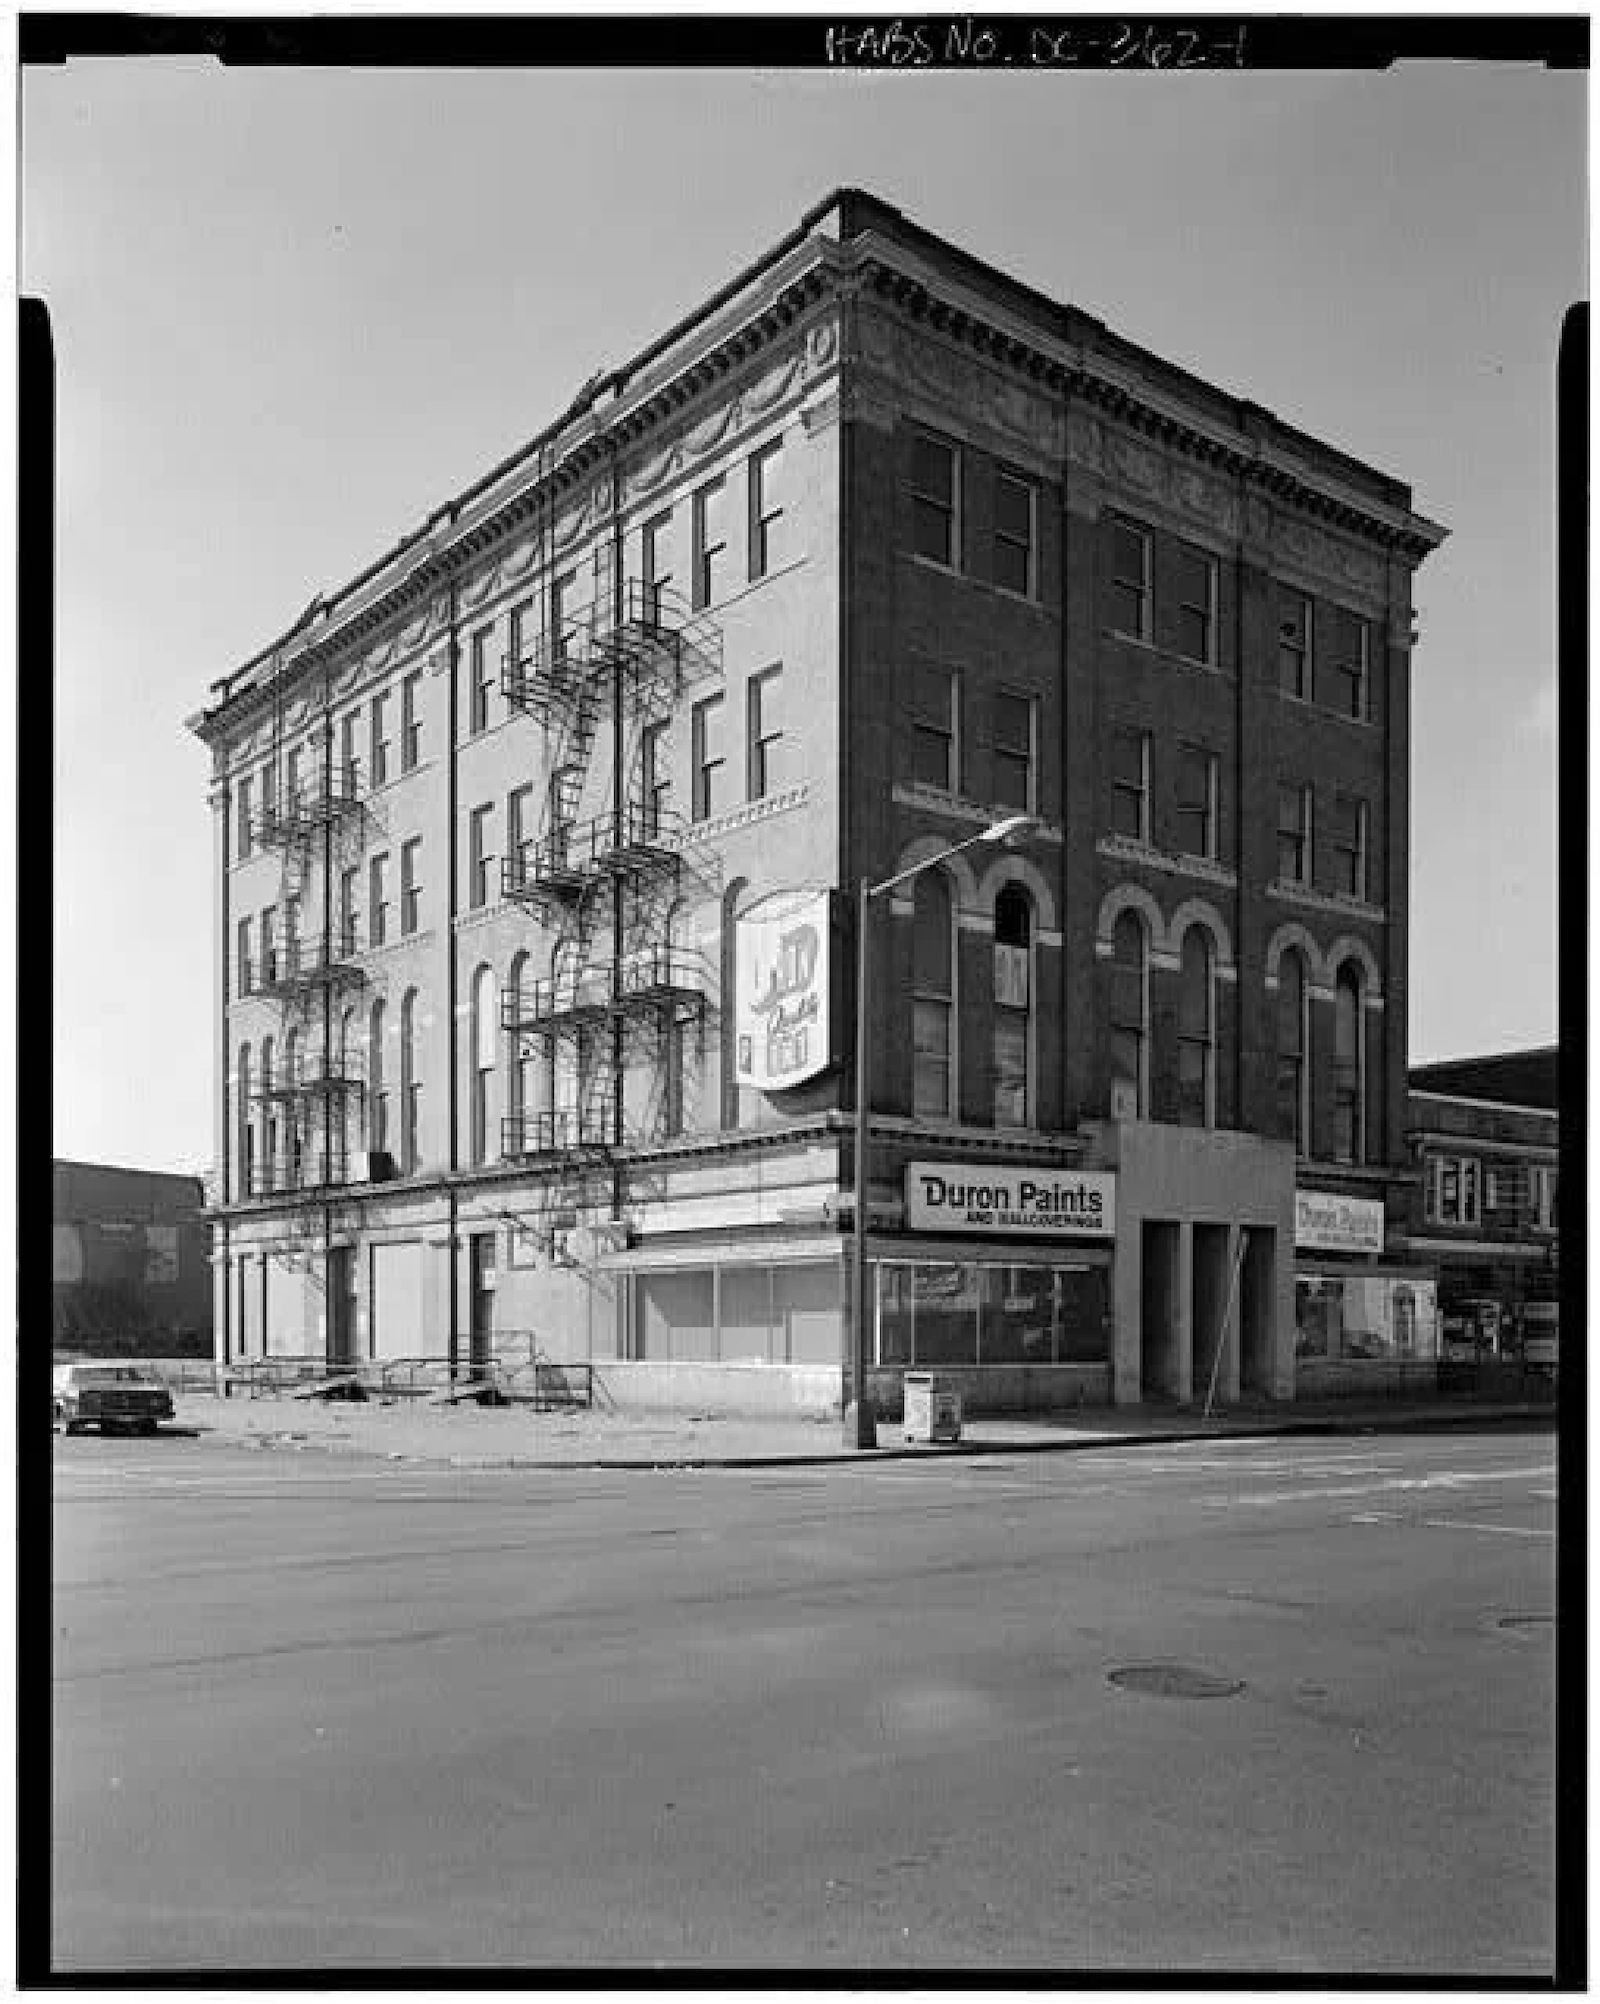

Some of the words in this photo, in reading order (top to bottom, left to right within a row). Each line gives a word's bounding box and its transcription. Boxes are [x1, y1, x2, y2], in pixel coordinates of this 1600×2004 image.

[920, 1177, 1009, 1209] Duron
[1020, 1181, 1102, 1212] Paints
[967, 1212, 993, 1225] AND
